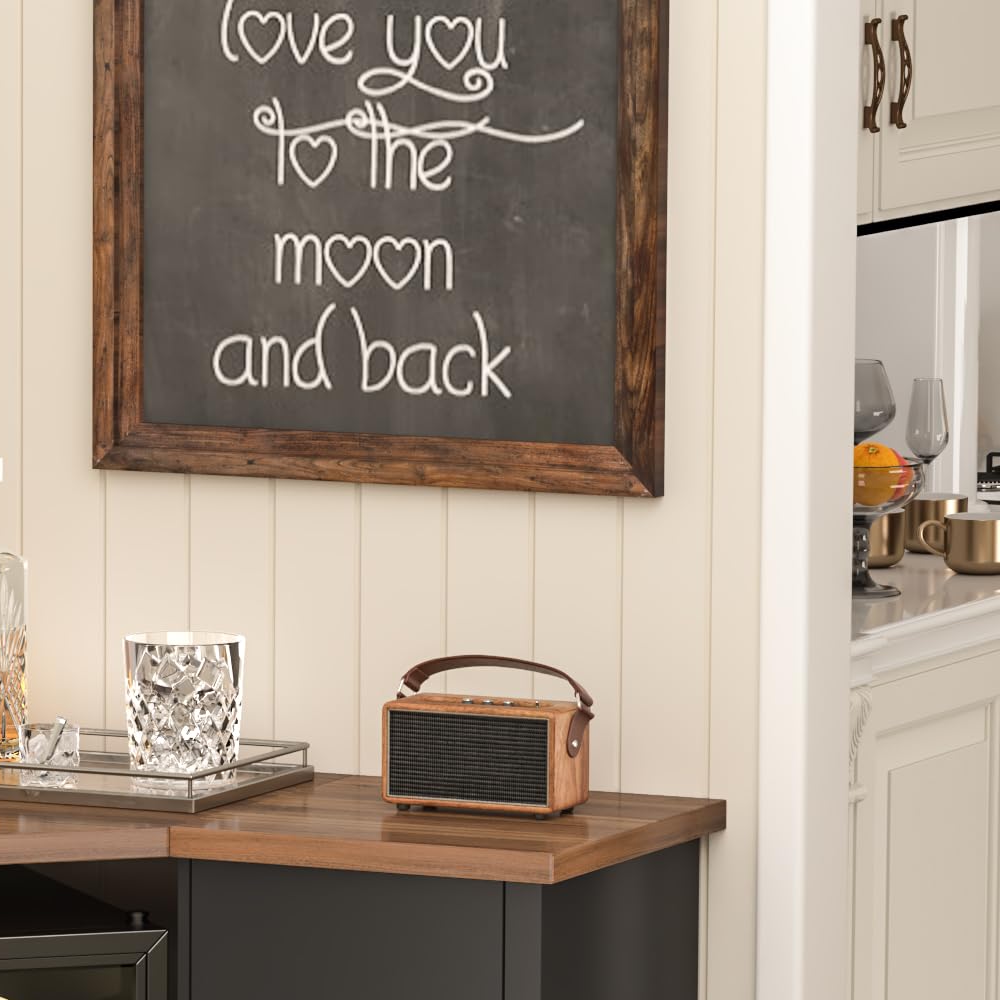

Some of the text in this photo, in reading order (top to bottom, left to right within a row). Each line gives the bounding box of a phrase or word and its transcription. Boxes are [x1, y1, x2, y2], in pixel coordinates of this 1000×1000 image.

[221, 0, 508, 102] love you
[253, 97, 495, 191] to the
[274, 232, 454, 290] moon
[212, 303, 512, 399] and back
